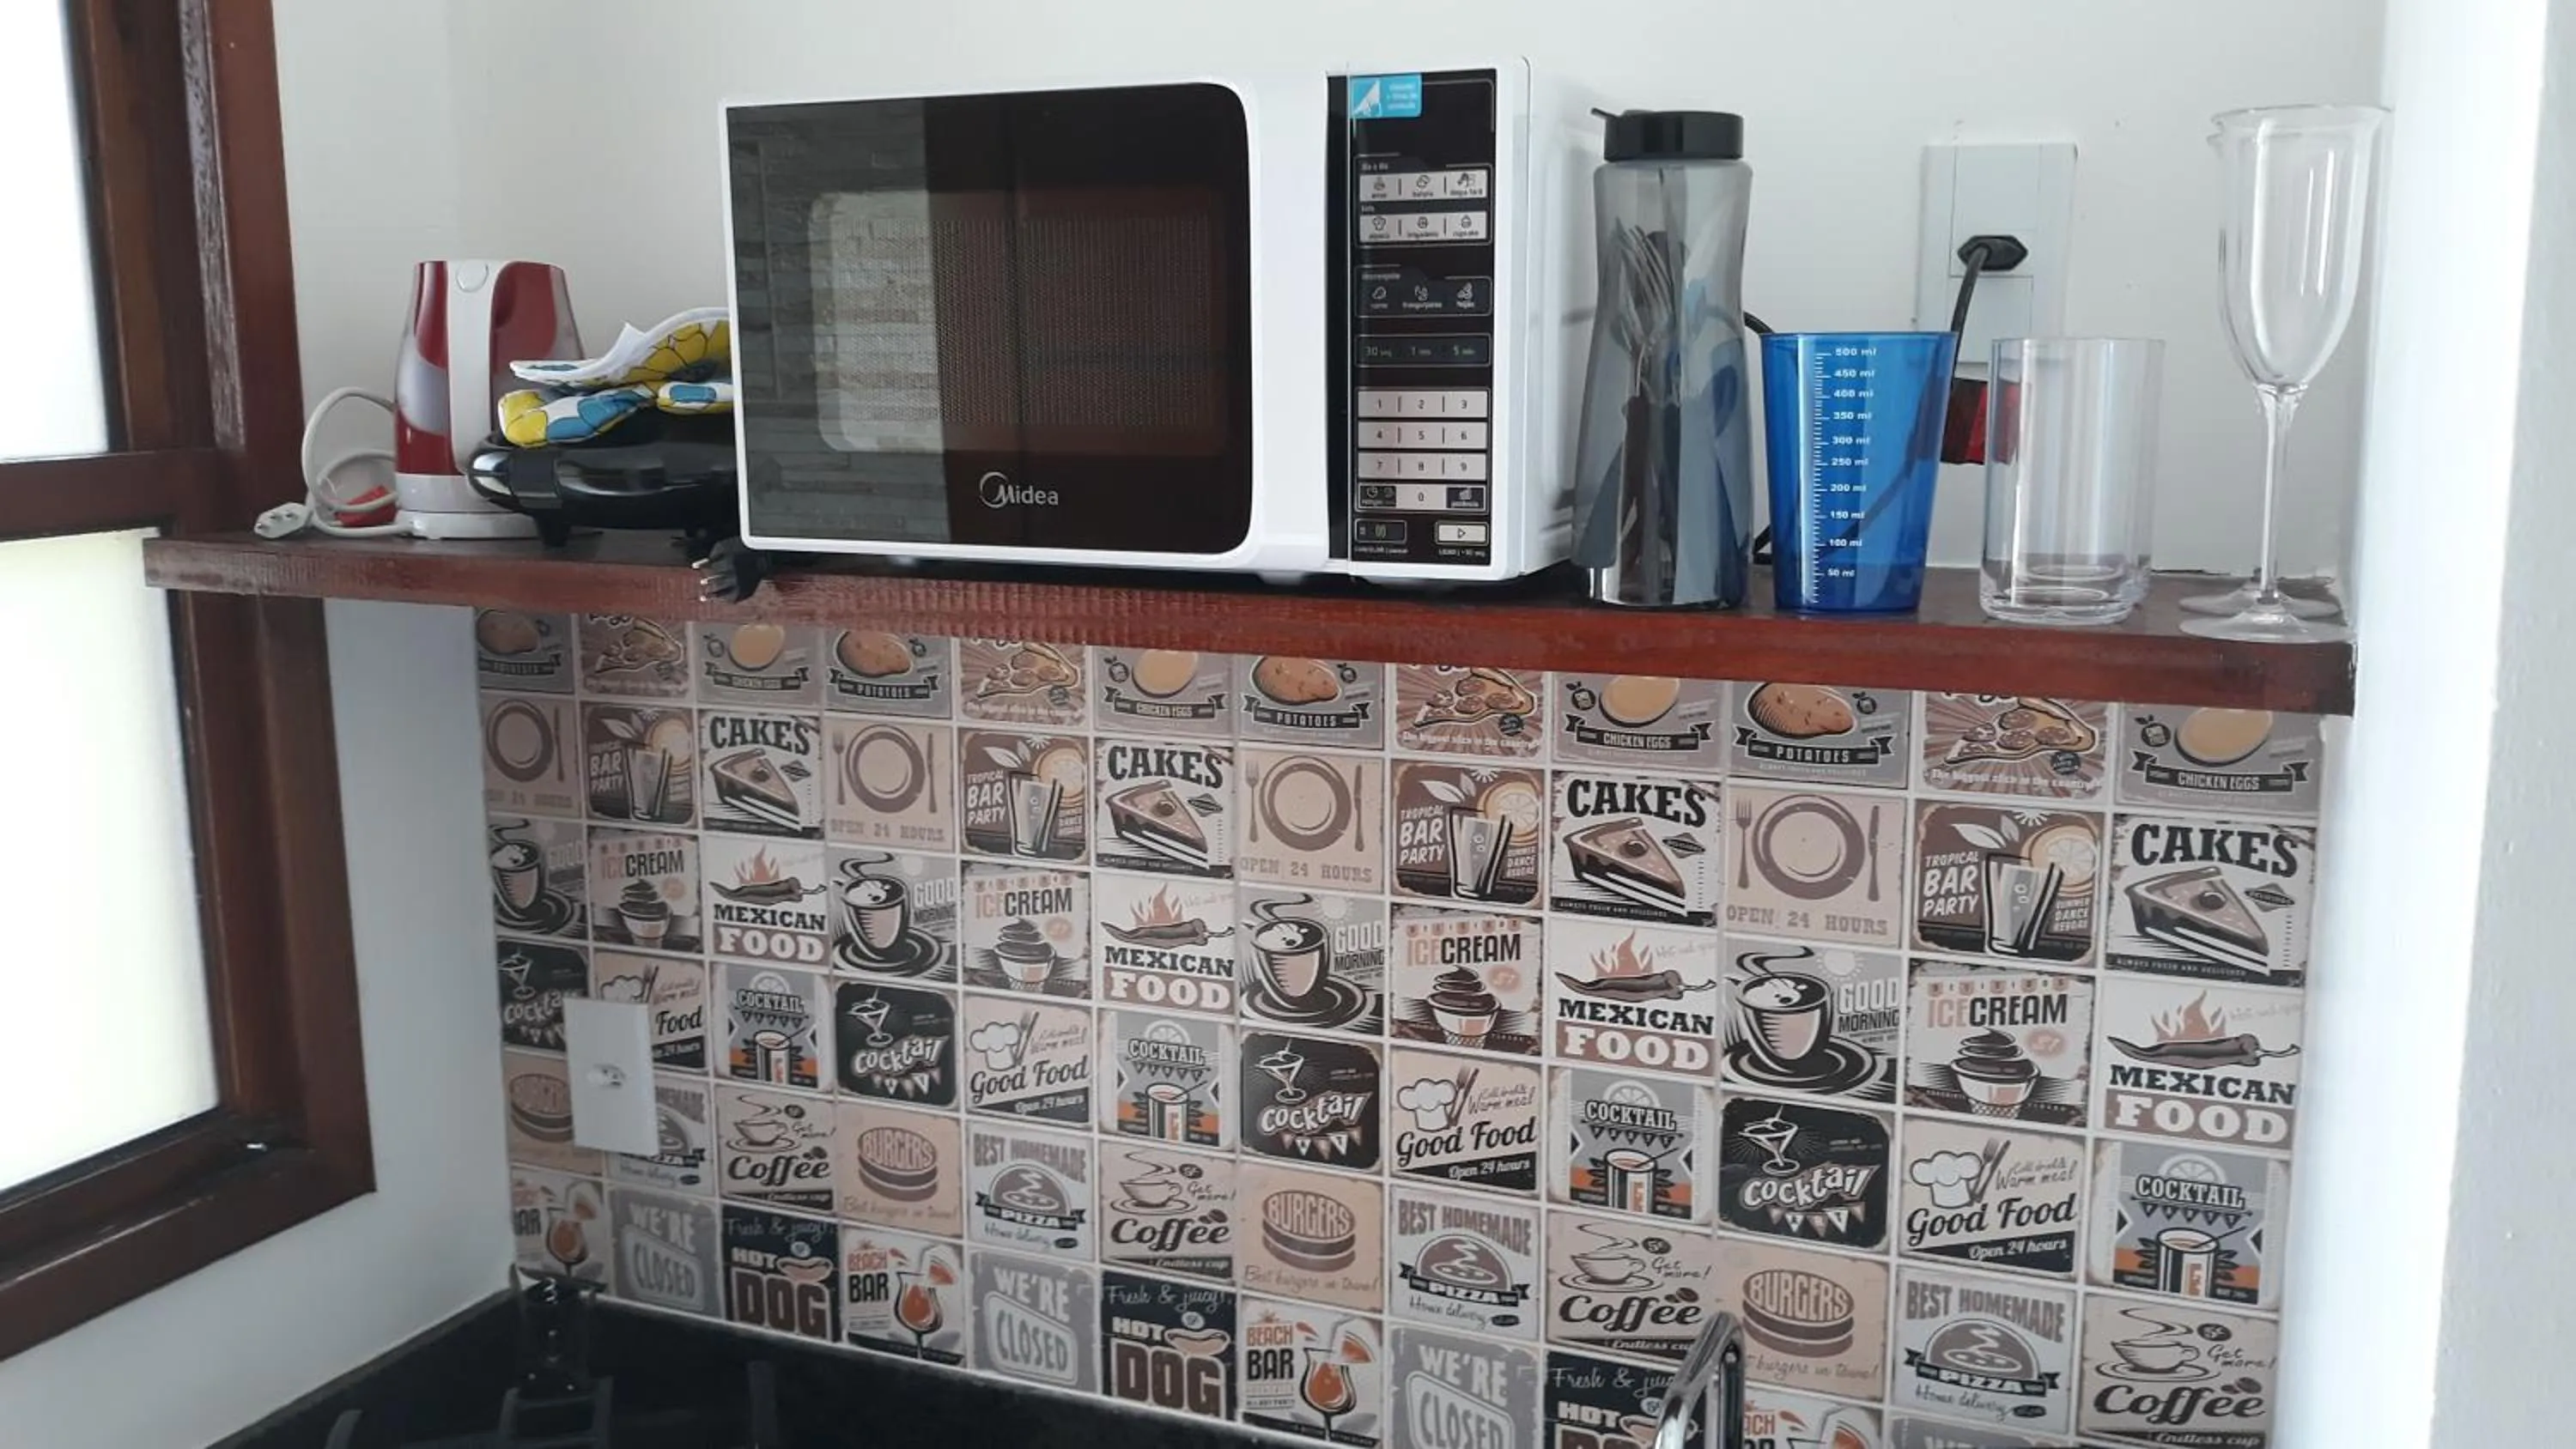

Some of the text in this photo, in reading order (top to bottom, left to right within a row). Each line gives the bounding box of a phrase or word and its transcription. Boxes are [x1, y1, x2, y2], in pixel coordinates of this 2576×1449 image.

[1377, 399, 1381, 409] 1
[1419, 400, 1424, 409] 2
[1461, 400, 1467, 409] 3
[1377, 431, 1382, 440] 4
[1419, 431, 1424, 440] 5
[1461, 431, 1467, 440] 6
[1856, 436, 1870, 445] ml
[1419, 462, 1424, 470] 8
[1461, 462, 1467, 470] 9
[980, 471, 1058, 508] Midea
[1419, 493, 1424, 501] 0
[1276, 712, 1337, 727] POTATOES
[710, 716, 811, 755] CAKES
[1603, 731, 1672, 749] CHICKEN EGGS
[590, 750, 623, 773] BAR
[1107, 746, 1224, 789] CAKES
[1777, 746, 1850, 763] POTATOES
[967, 780, 1004, 808] BAR
[2178, 772, 2260, 791] CHICKEN EGGS
[967, 805, 1007, 826] PARTY
[1400, 804, 1443, 817] TROPICAL
[1567, 779, 1707, 828] CAKES
[1400, 816, 1443, 845] BAR
[1399, 843, 1445, 865] PARTY
[1924, 850, 1979, 866] TROPICAL
[2130, 823, 2298, 877] CAKES
[1240, 858, 1373, 882] OPEN 24 HOURS
[1923, 864, 1977, 897] BAR
[714, 904, 826, 931] MEXICAN
[1923, 894, 1980, 918] PARTY
[2055, 907, 2089, 921] DANCE
[1726, 905, 1888, 936] OPEN 24 HOURS
[718, 926, 825, 962] FOOD
[1333, 921, 1384, 954] GOOD
[1104, 945, 1235, 978] MEXICAN
[1333, 949, 1385, 972] MORNING
[736, 990, 805, 1014] COCKTAIL
[1109, 971, 1231, 1011] FOOD
[1838, 977, 1899, 1014] GOOD
[655, 1006, 702, 1036] Food
[1558, 998, 1715, 1035] MEXICAN
[1838, 1007, 1901, 1033] MORNING
[1127, 1039, 1206, 1065] COCKTAIL
[1564, 1026, 1710, 1070] FOOD
[970, 1055, 1091, 1103] Good Food
[2110, 1064, 2296, 1106] MEXICAN
[1585, 1100, 1677, 1131] COCKTAIL
[2115, 1094, 2287, 1143] FOOD
[861, 1129, 934, 1170] BURGERS
[1396, 1116, 1538, 1167] Good Food
[728, 1155, 831, 1186] Coffee
[973, 1133, 1087, 1183] BEST HOMEMADE
[1448, 1159, 1530, 1179] Open 24 hours
[2136, 1175, 2246, 1210] COCKTAIL
[999, 1209, 1060, 1227] PIZZA
[1267, 1191, 1352, 1238] BURGERS
[1398, 1199, 1532, 1257] BEST HOMEMADE
[1908, 1192, 2077, 1246] Good Food
[1110, 1218, 1230, 1252] Coffee
[732, 1247, 777, 1269] HOT
[1968, 1238, 2067, 1261] Open 24 hours
[1651, 1256, 1681, 1272] Get
[848, 1273, 890, 1303] BAR
[993, 1267, 1071, 1323] WE'RE
[1428, 1282, 1500, 1305] PIZZA
[1750, 1270, 1852, 1322] BURGERS
[732, 1267, 829, 1342] DOG
[1559, 1294, 1704, 1332] Coffee
[1905, 1280, 2065, 1343] BEST HOMEMADE
[996, 1311, 1068, 1372] CLOSED
[1112, 1316, 1166, 1341] HOT
[1246, 1325, 1293, 1346] BEACH
[1612, 1339, 1668, 1350] Endless
[2208, 1344, 2244, 1362] Get
[1246, 1349, 1294, 1380] BAR
[1419, 1345, 1509, 1408] WE'RE
[1549, 1367, 1634, 1388] Fresh &
[1112, 1339, 1225, 1419] DOG
[1937, 1370, 2023, 1394] PIZZA
[1558, 1400, 1621, 1428] HOT
[2093, 1384, 2267, 1426] Coffee
[1420, 1391, 1503, 1449] CLOSED
[2155, 1432, 2262, 1448] Endless cup
